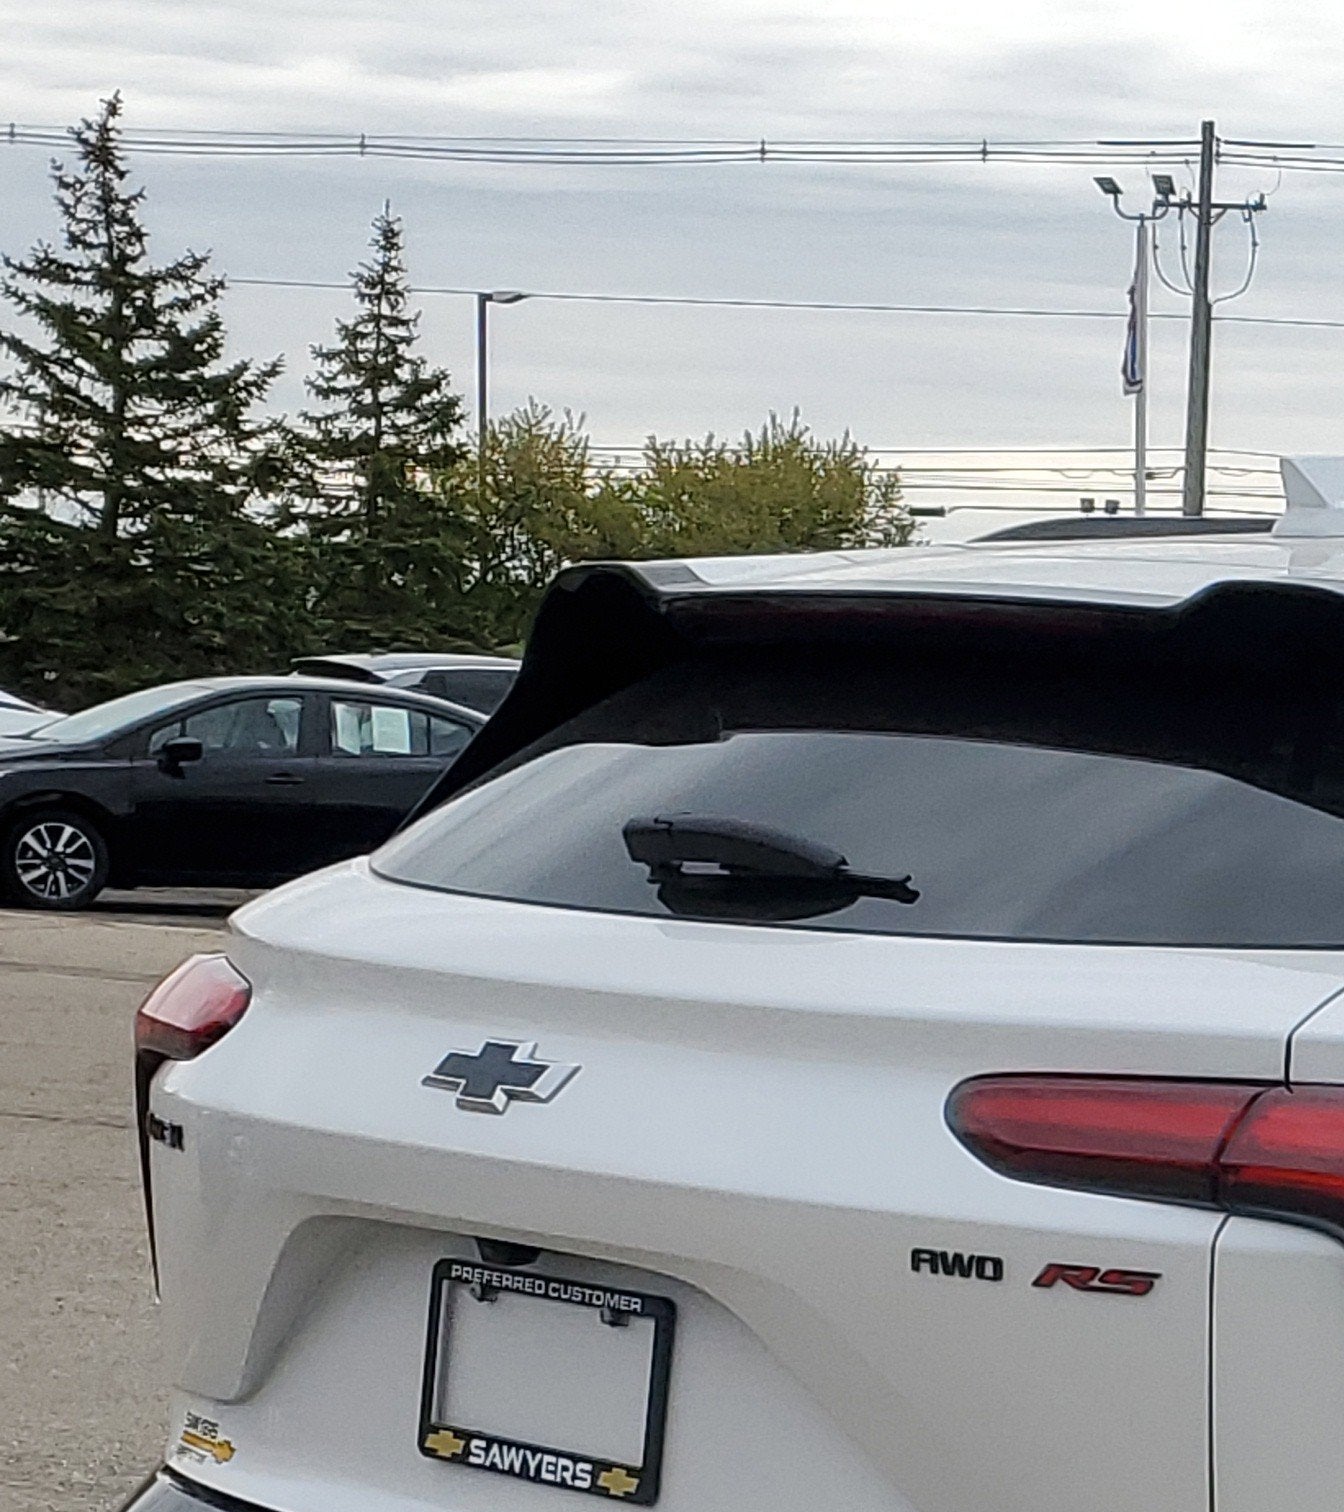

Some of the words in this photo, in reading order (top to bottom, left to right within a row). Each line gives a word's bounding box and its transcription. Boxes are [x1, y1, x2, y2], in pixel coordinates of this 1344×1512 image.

[451, 1265, 545, 1294] PREFERRED
[548, 1283, 642, 1312] CUSTOMER
[910, 1248, 1003, 1281] AWD
[1031, 1263, 1162, 1295] RS
[468, 1439, 593, 1488] SAWYERS
